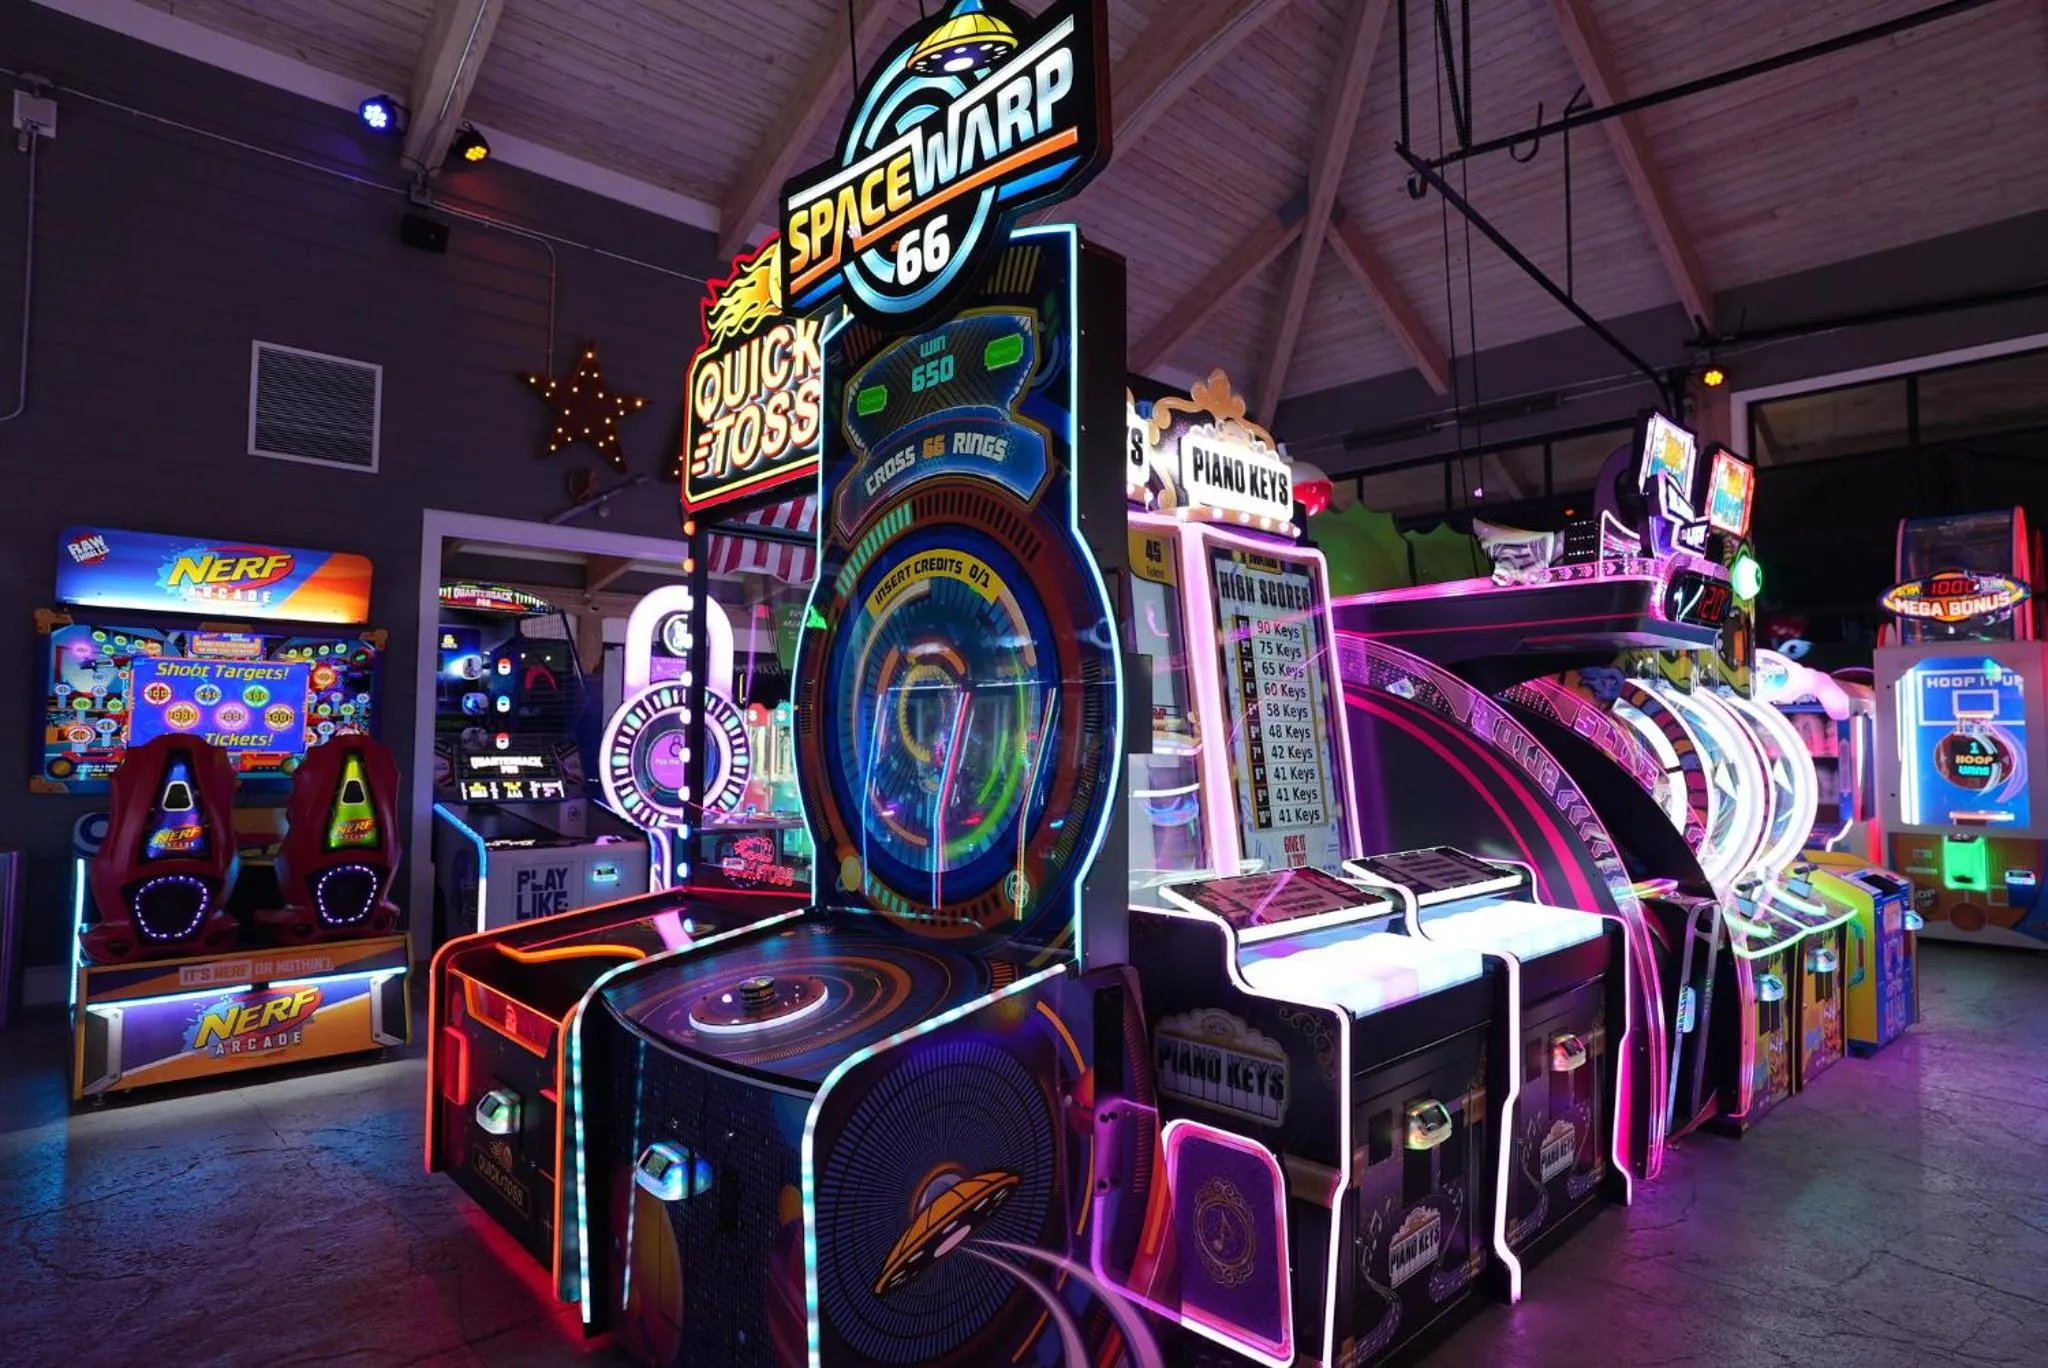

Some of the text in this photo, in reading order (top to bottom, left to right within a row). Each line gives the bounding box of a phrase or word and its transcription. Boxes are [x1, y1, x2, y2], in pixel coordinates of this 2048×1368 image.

[897, 214, 950, 286] 66
[695, 318, 822, 424] QUICK
[911, 355, 954, 393] 650
[712, 377, 822, 476] TOSS
[865, 432, 1008, 496] CROSS 66 RINGS
[1192, 446, 1246, 494] PIANO
[1250, 462, 1289, 506] KEYS
[68, 535, 105, 558] RAW
[1145, 539, 1162, 563] 45
[168, 553, 293, 586] NERF
[874, 557, 991, 605] INSERT CREDITS 0/1
[1219, 570, 1256, 603] HIGH
[187, 586, 273, 603] ARCADE
[452, 587, 513, 603] QUARTERBACK
[1895, 592, 2012, 617] MEGA BONUS
[1256, 621, 1300, 642] 90 Keys
[1260, 641, 1302, 660] 75 Keys
[156, 661, 290, 681] Shoot Targets!
[1262, 662, 1304, 681] 65 Keys
[1264, 682, 1306, 702] 60 Keys
[1926, 677, 1975, 689] HOOP
[1266, 704, 1308, 722] 58 Keys
[205, 732, 275, 747] Tickets!
[1269, 725, 1311, 743] 48 Keys
[1271, 746, 1313, 763] 42 Keys
[1955, 754, 1993, 765] HOOP
[1274, 767, 1315, 784] 41 Keys
[1276, 787, 1318, 804] 41 Keys
[336, 819, 374, 834] NERF
[1278, 807, 1320, 825] 41 Keys
[152, 826, 201, 844] NERF
[517, 868, 568, 892] PLAY
[517, 891, 569, 920] LIKE
[184, 967, 211, 983] IT'S
[213, 964, 250, 979] NERF
[255, 961, 272, 976] OR
[193, 986, 319, 1049] NERF
[215, 1031, 302, 1056] ARCADE
[1157, 1036, 1285, 1101] PIANO KEYS
[1390, 1219, 1440, 1275] PIANO KEYS
